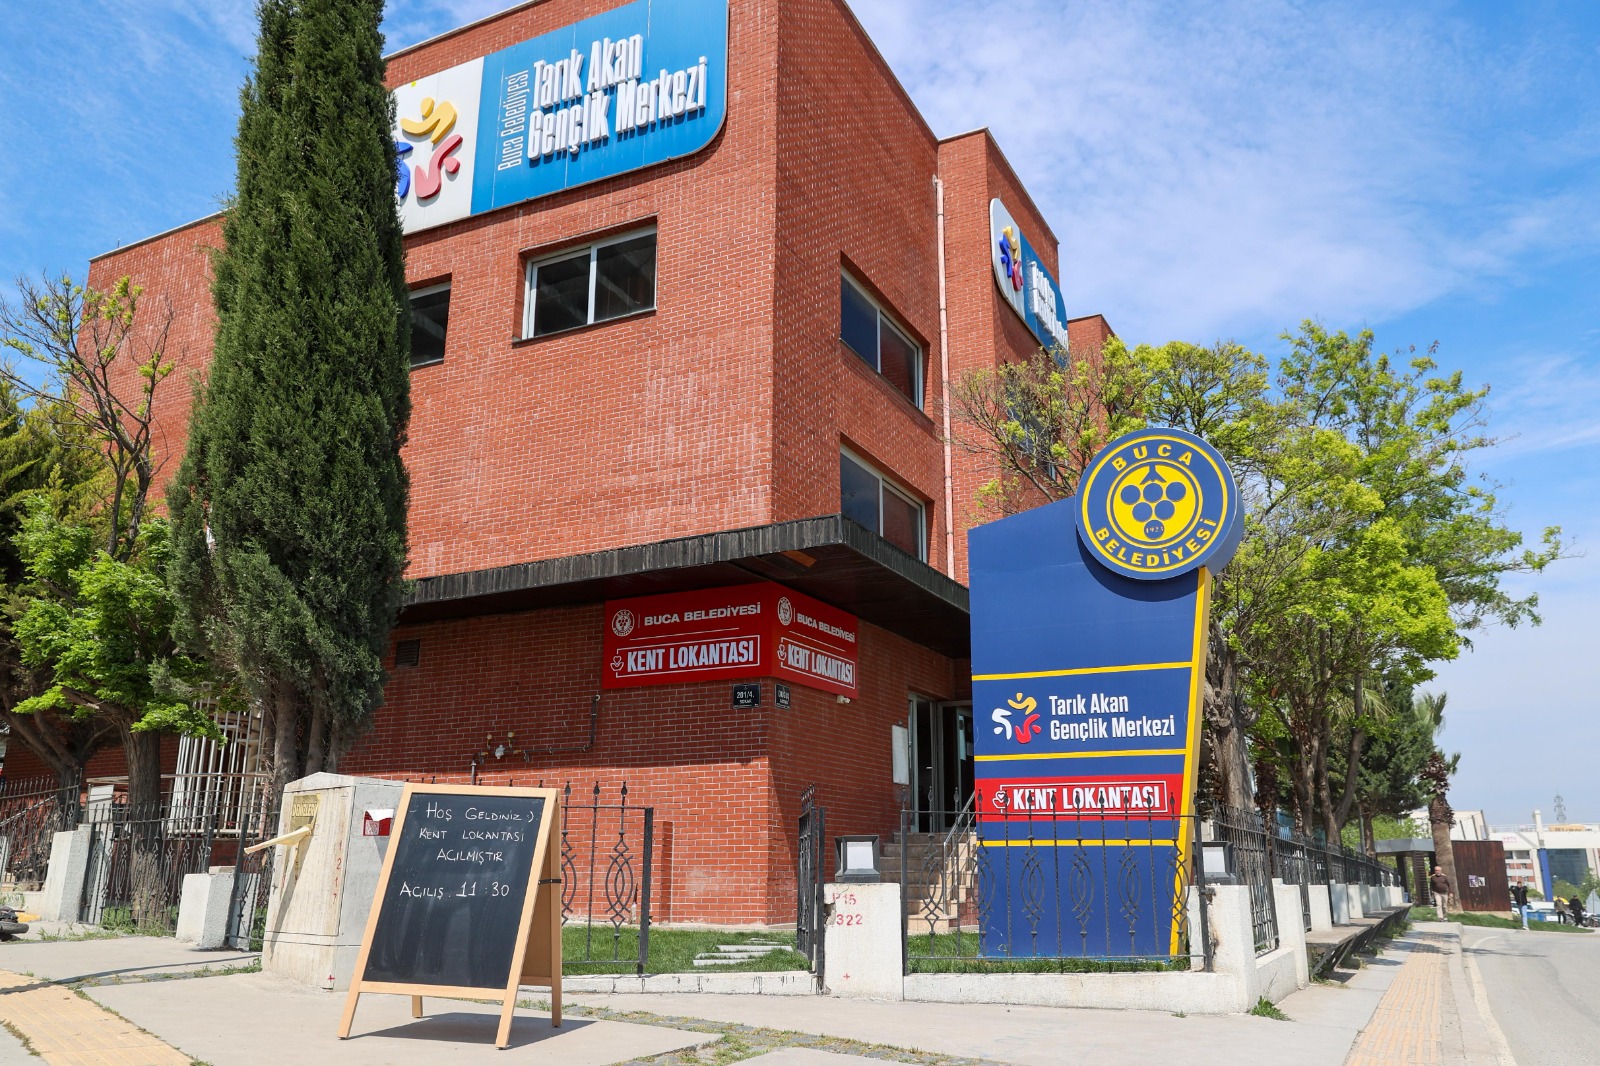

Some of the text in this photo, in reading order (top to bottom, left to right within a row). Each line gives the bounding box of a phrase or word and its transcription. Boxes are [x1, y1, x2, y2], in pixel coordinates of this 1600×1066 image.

[533, 33, 643, 111] Tarık Akan
[497, 69, 530, 171] Buca Belediyesi
[527, 55, 708, 160] Gençlik Merkezi
[1111, 443, 1193, 472] BUCA
[1095, 518, 1217, 567] BELEDİYESİ
[644, 613, 680, 626] BUCA
[684, 602, 761, 621] BELEDİYESİ
[797, 612, 856, 643] BUCA BELEDİYESİ
[627, 640, 754, 672] KENT LOKANTASI
[787, 644, 853, 684] KENT LOKANTASI
[1048, 693, 1129, 716] Tarık Akan
[1050, 714, 1175, 742] Gençlik Merkezi
[1013, 786, 1160, 810] KENT LOKANTASI
[419, 827, 448, 840] KENT
[836, 913, 863, 926] 322
